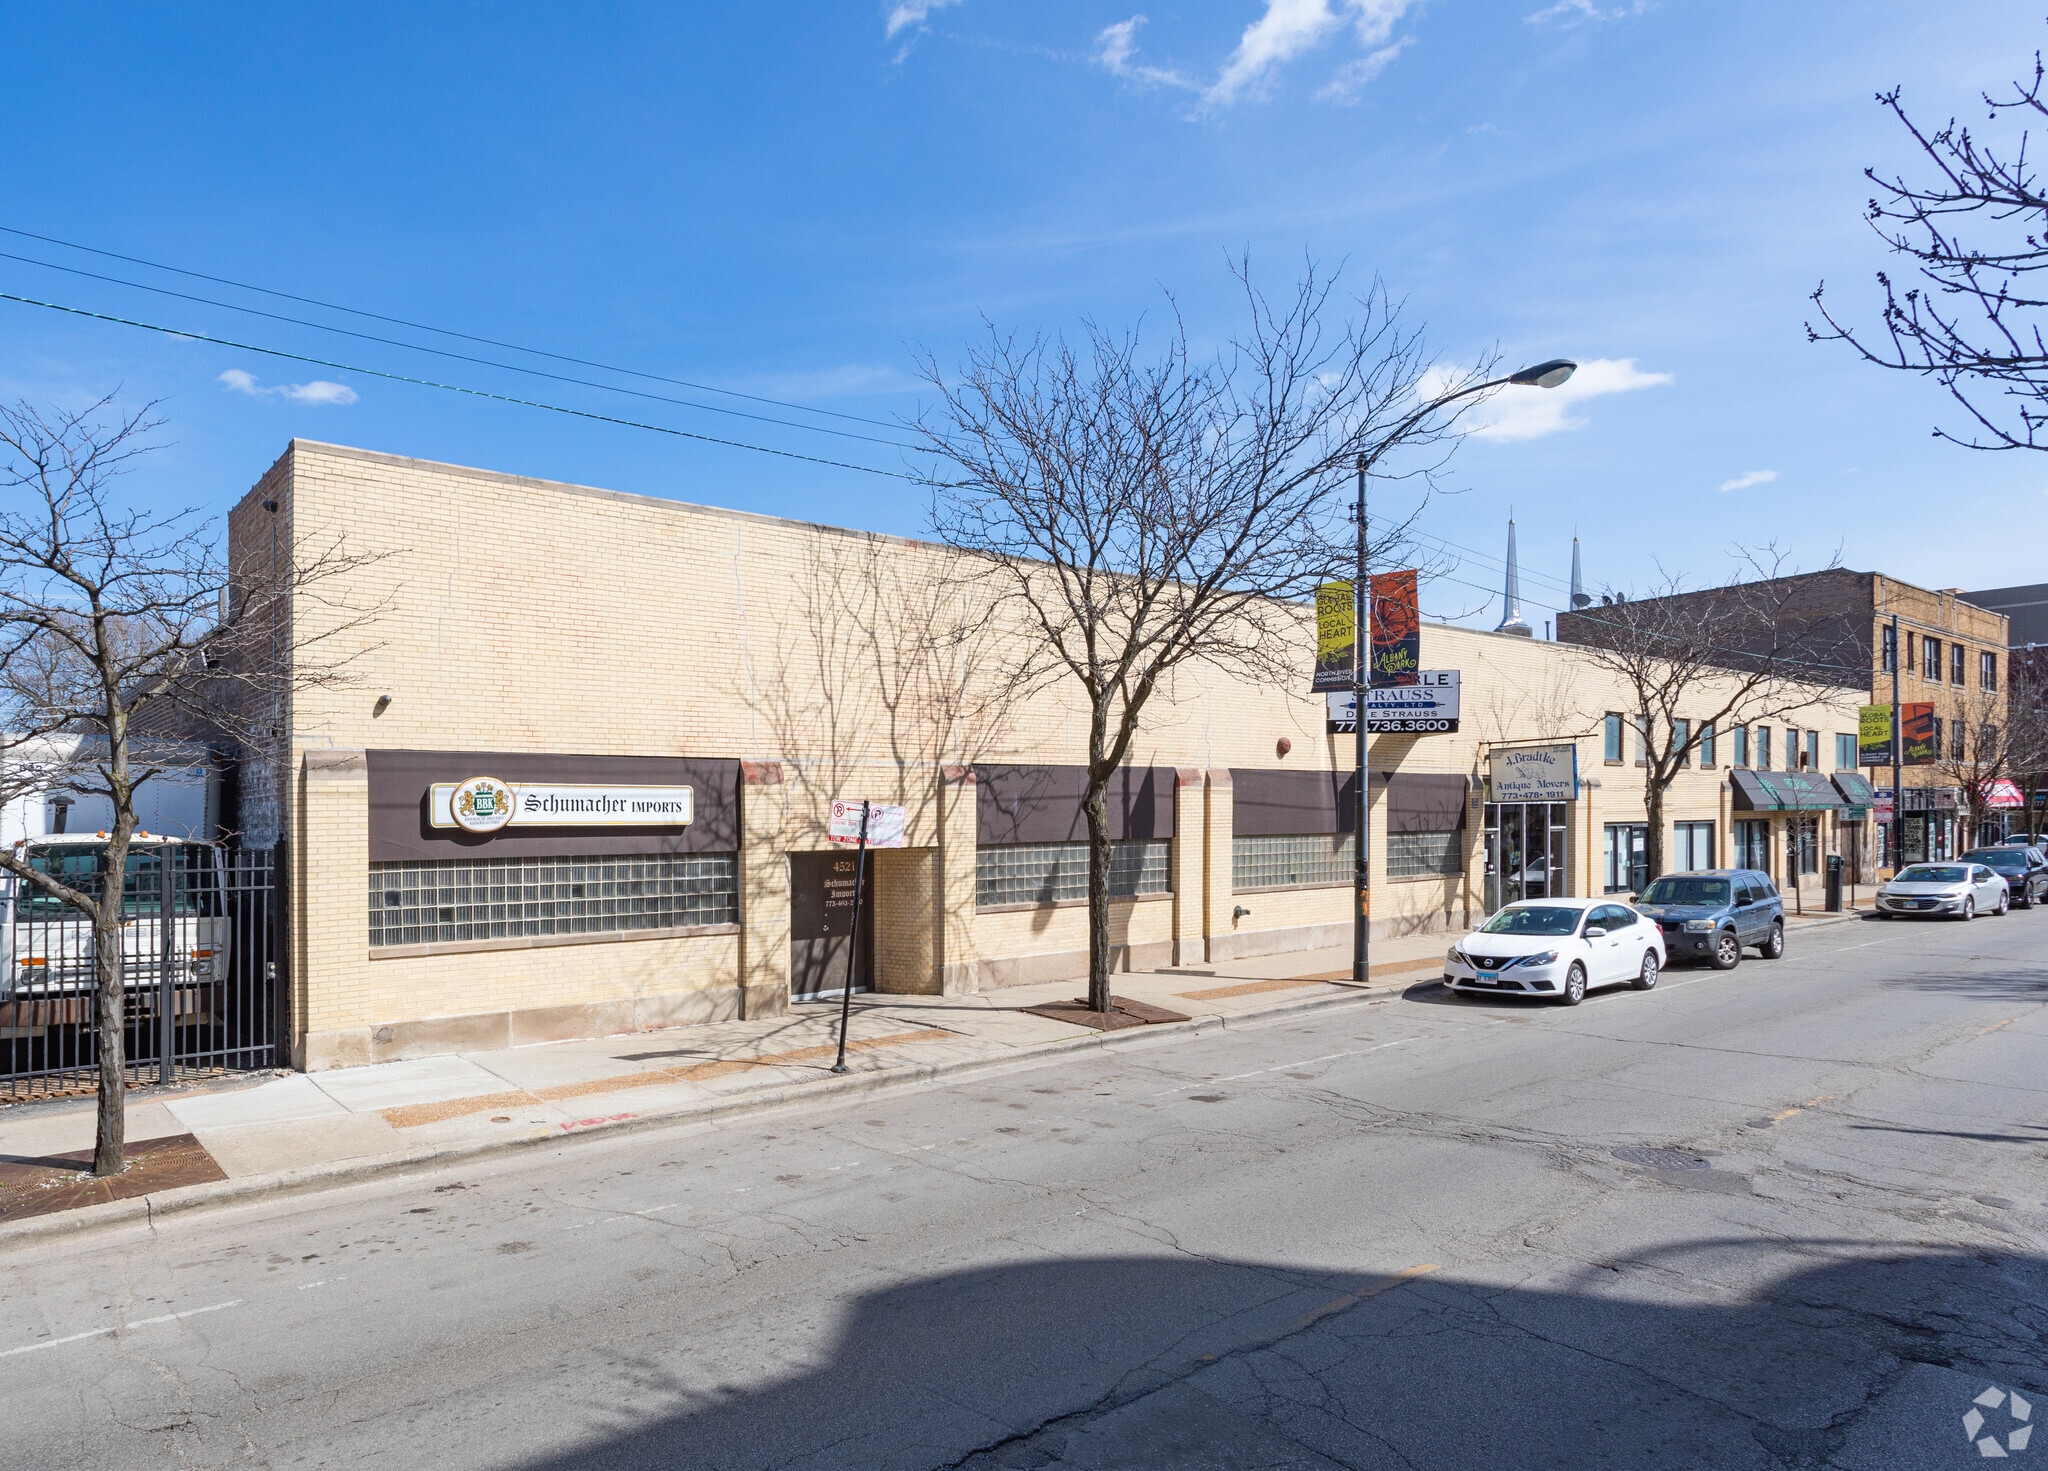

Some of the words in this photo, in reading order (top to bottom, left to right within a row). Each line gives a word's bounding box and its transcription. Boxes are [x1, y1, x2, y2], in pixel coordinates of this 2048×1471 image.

[1317, 601, 1353, 616] ROOTS
[1319, 619, 1346, 630] LOCAL
[1319, 626, 1353, 640] HEART
[1374, 648, 1408, 669] ALBANY
[1386, 658, 1417, 676] PARK
[1316, 669, 1336, 677] NORTH
[1315, 675, 1351, 683] COMMISSION
[1383, 710, 1438, 718] STRAUSS
[1336, 720, 1449, 732] 77.736.3600
[1496, 781, 1531, 791] Antique
[1537, 780, 1570, 789] Movers
[476, 798, 494, 810] BBK
[524, 794, 627, 815] Schumacher
[631, 801, 683, 813] IMPORTS
[833, 861, 855, 872] 4521
[823, 877, 865, 888] Schumacr
[830, 890, 856, 899] Import
